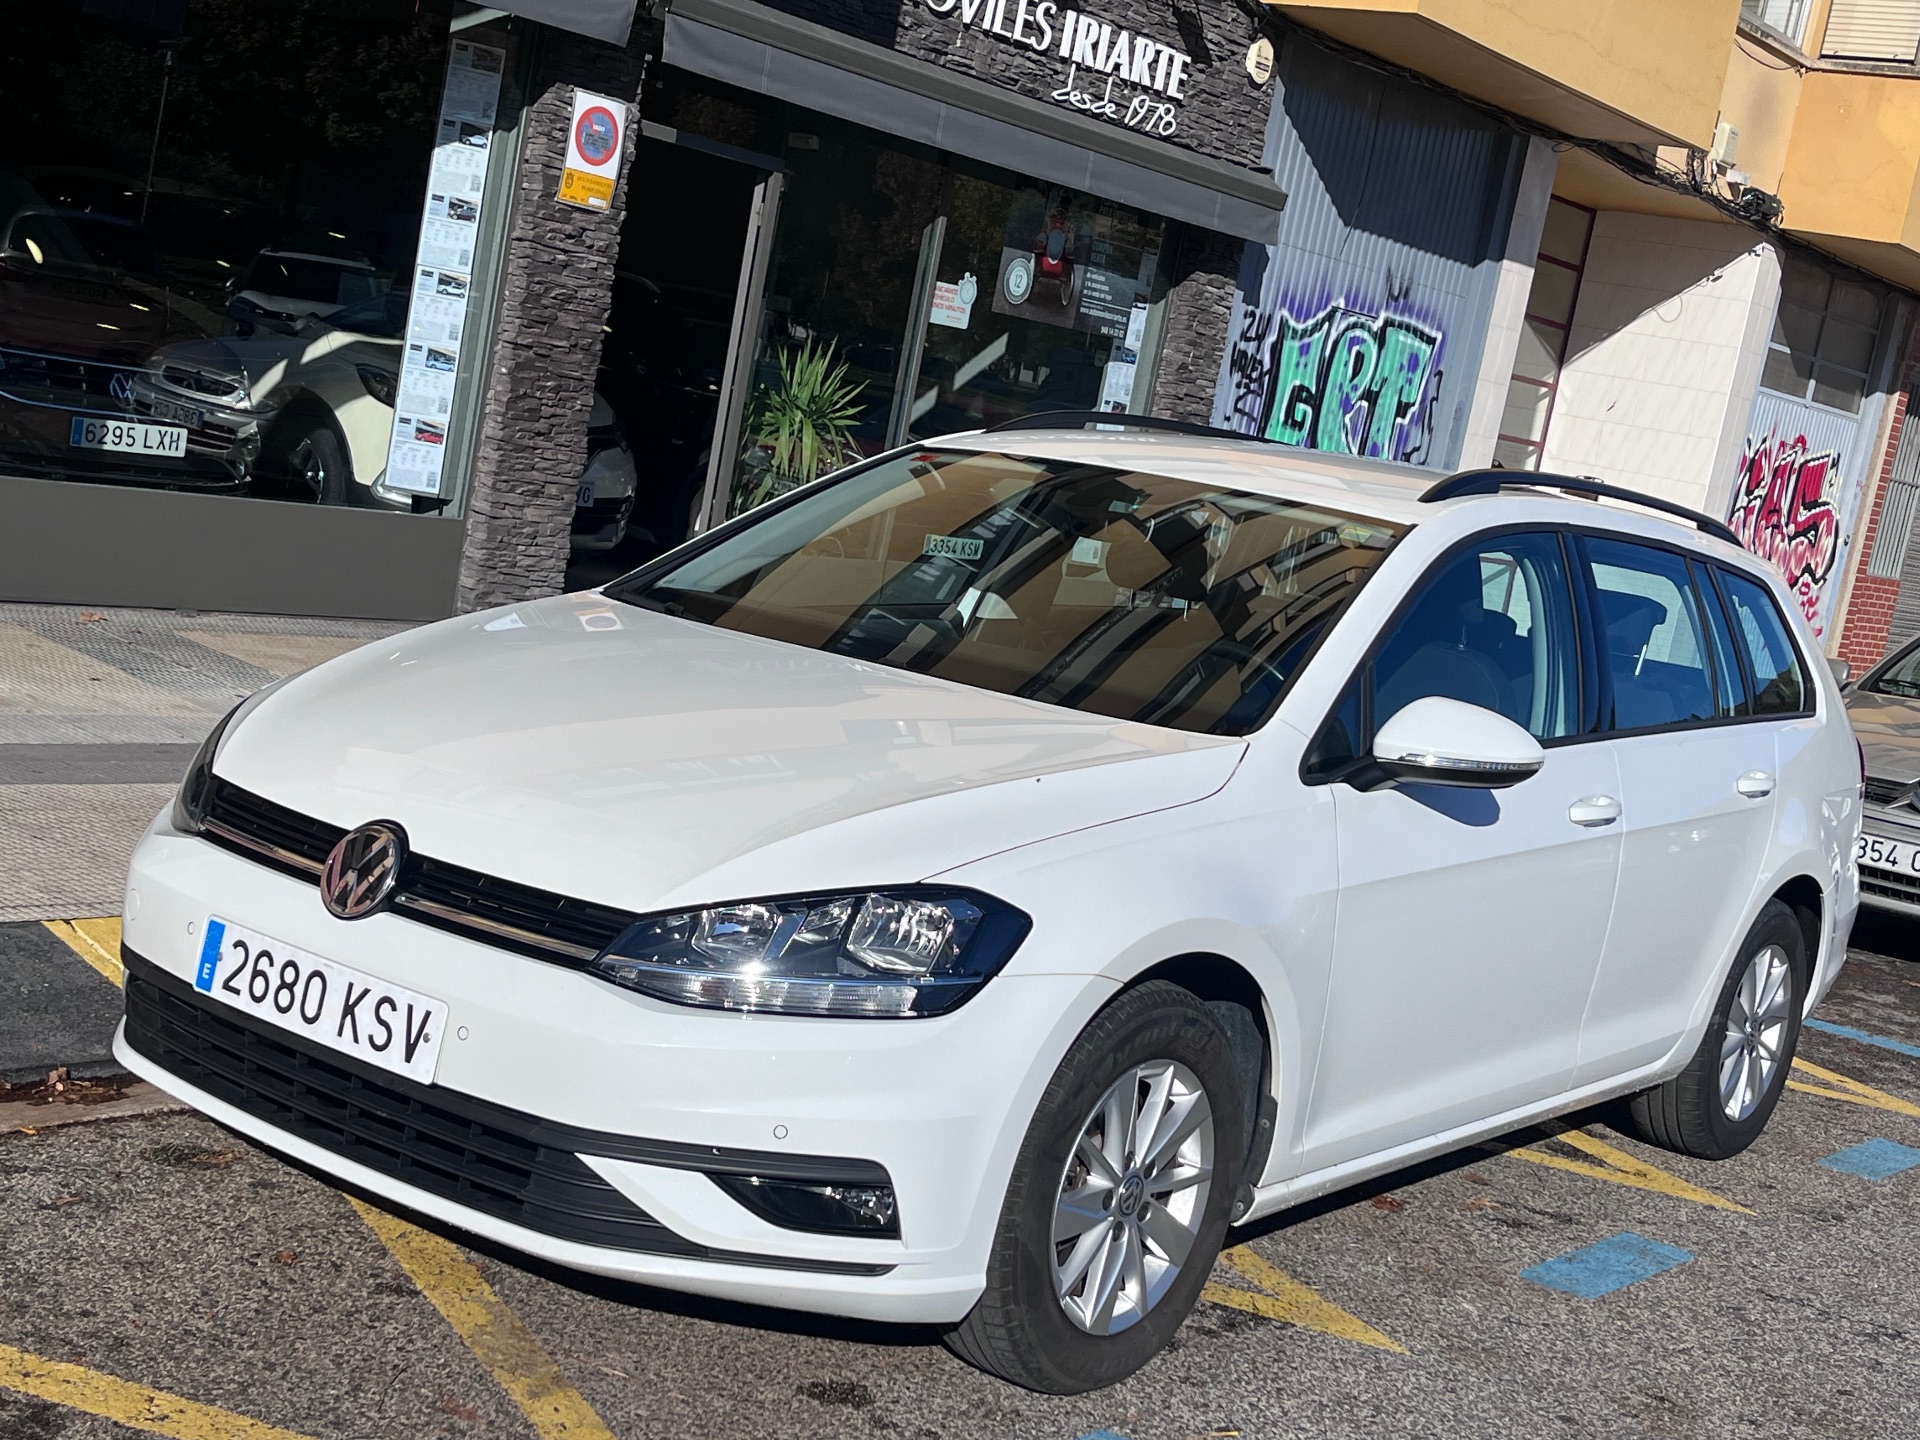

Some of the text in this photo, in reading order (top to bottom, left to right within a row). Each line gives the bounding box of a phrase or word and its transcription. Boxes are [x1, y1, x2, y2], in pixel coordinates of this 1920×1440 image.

[926, 0, 1056, 50] VILES
[1059, 10, 1191, 100] IRIARTE
[1051, 63, 1177, 136] desde 1978
[1013, 273, 1023, 289] 12
[85, 422, 180, 452] 6295 LXH
[930, 538, 958, 555] 3354
[222, 939, 432, 1064] 2680 KSV
